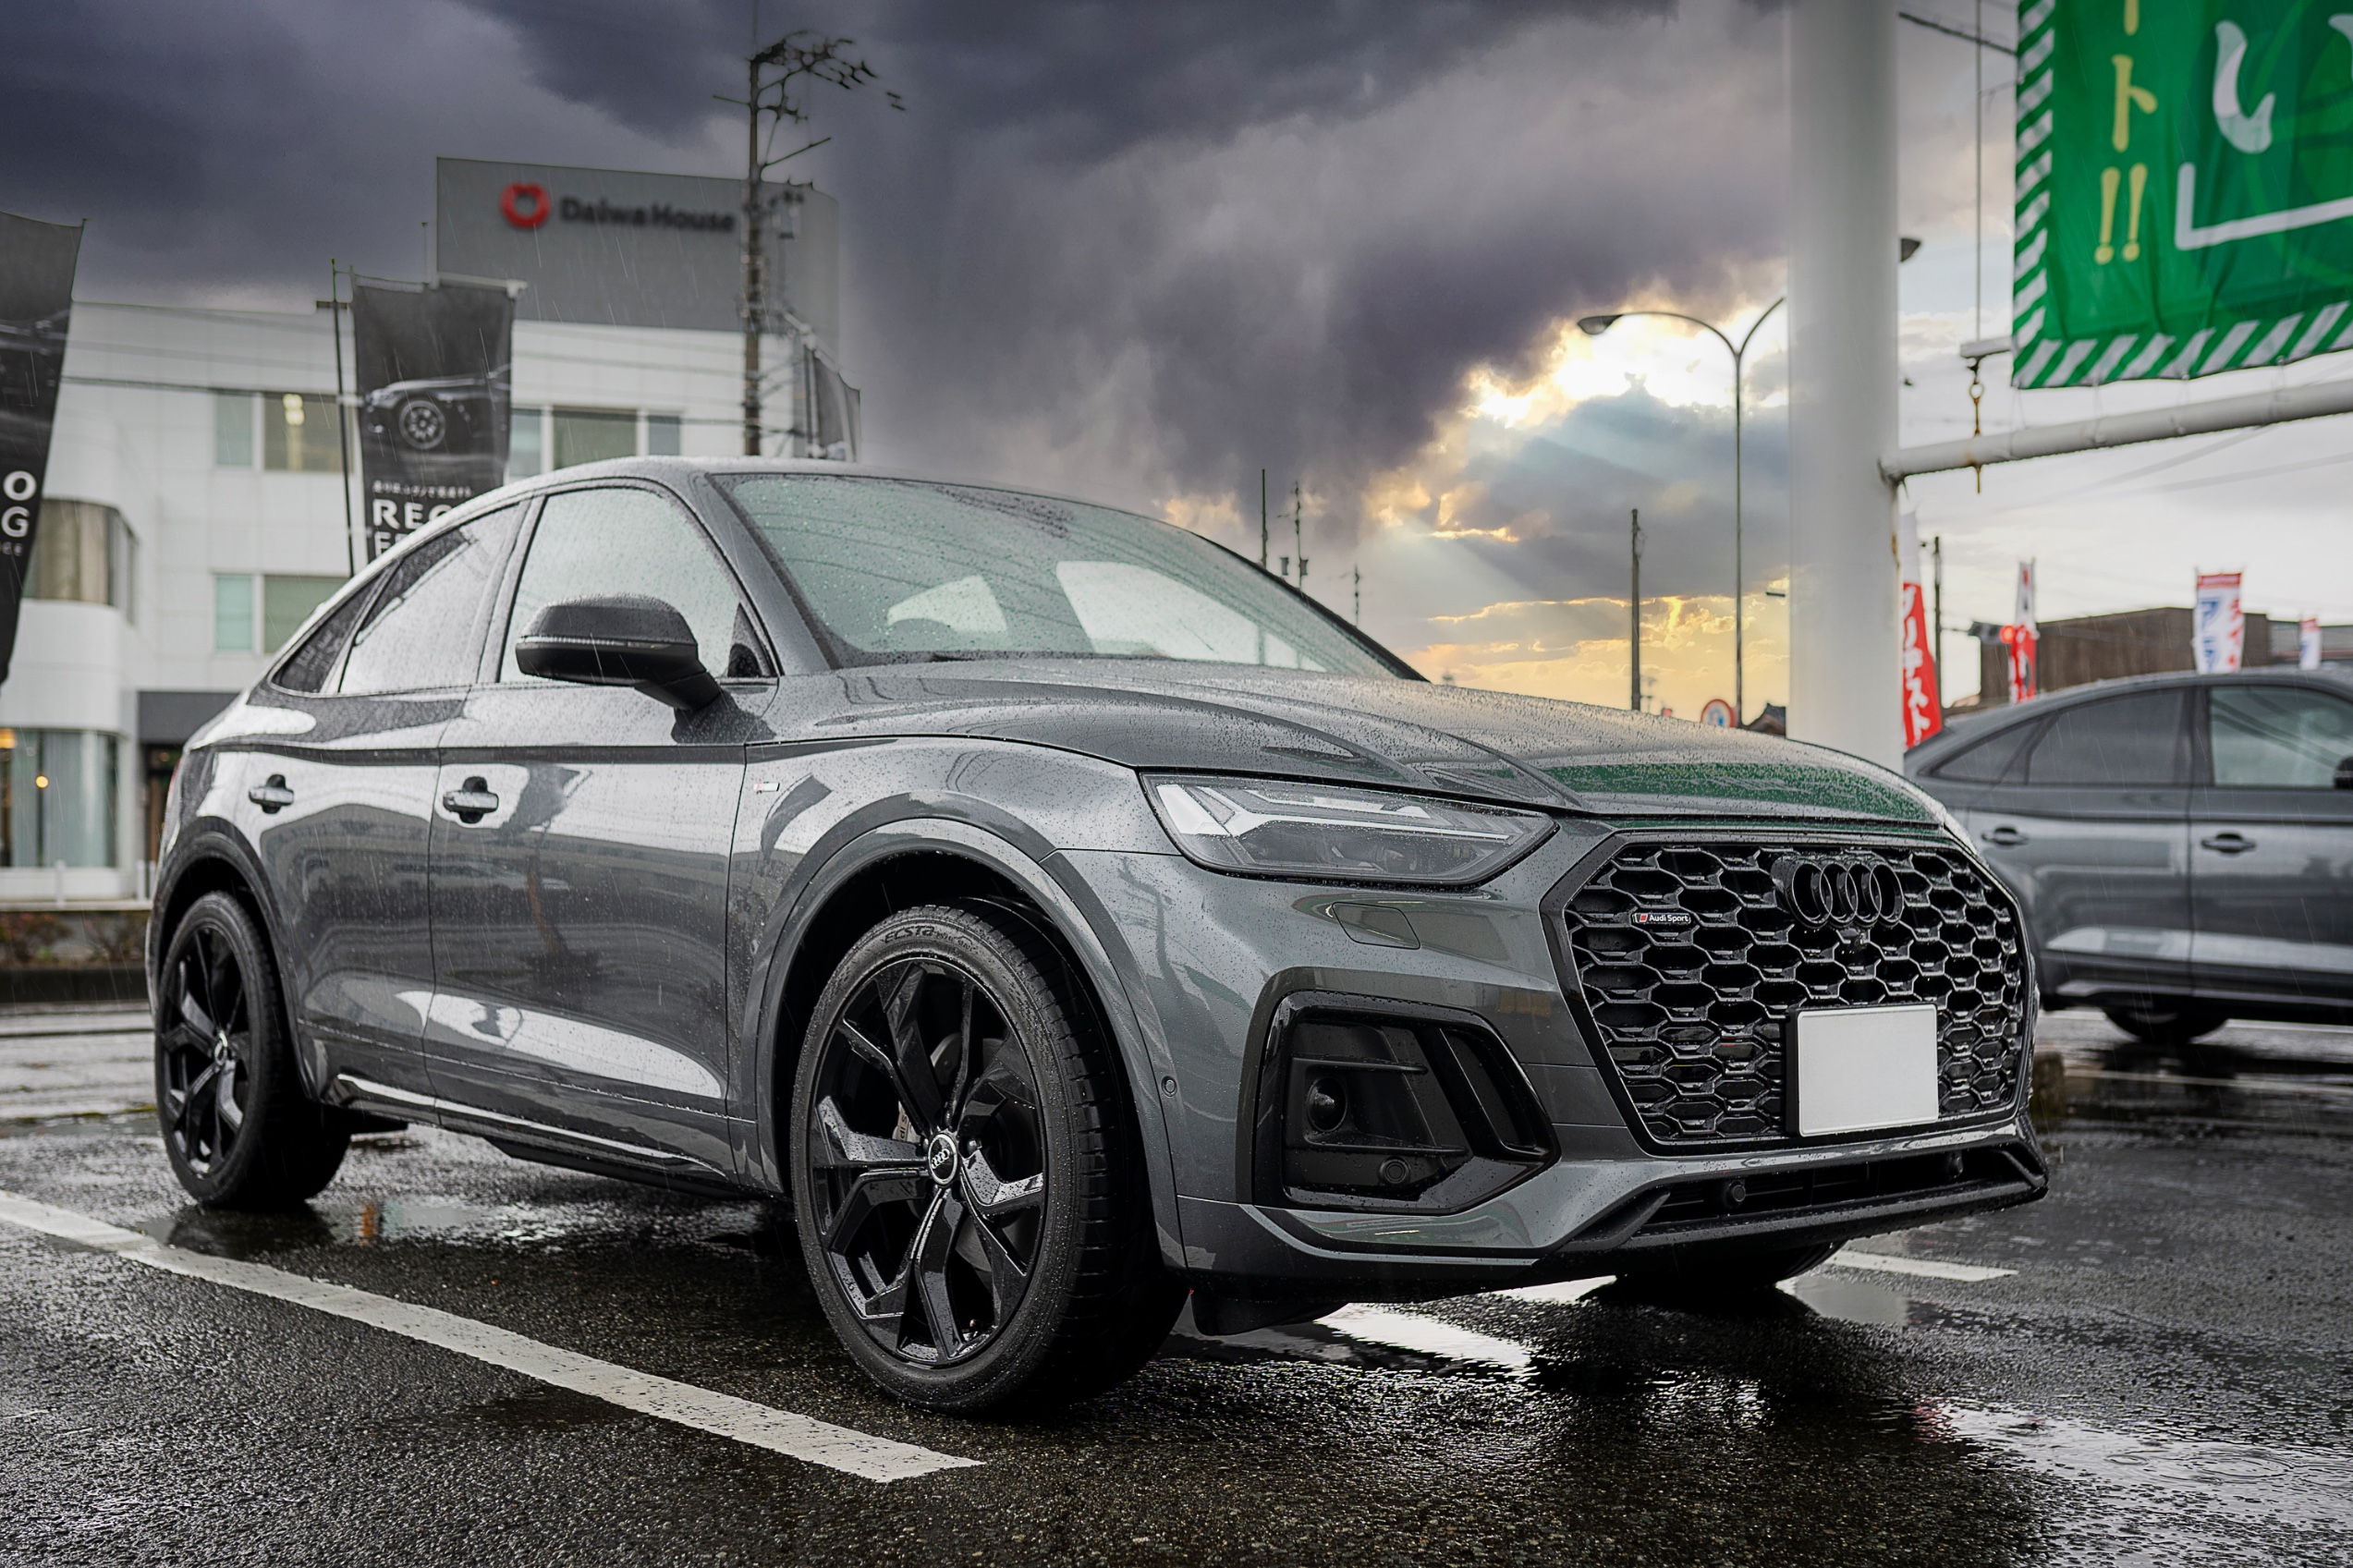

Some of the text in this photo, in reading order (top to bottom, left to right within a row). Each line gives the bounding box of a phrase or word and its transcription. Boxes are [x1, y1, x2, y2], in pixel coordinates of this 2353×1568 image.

[560, 195, 736, 233] Daiwa House
[1667, 915, 1689, 923] Sport
